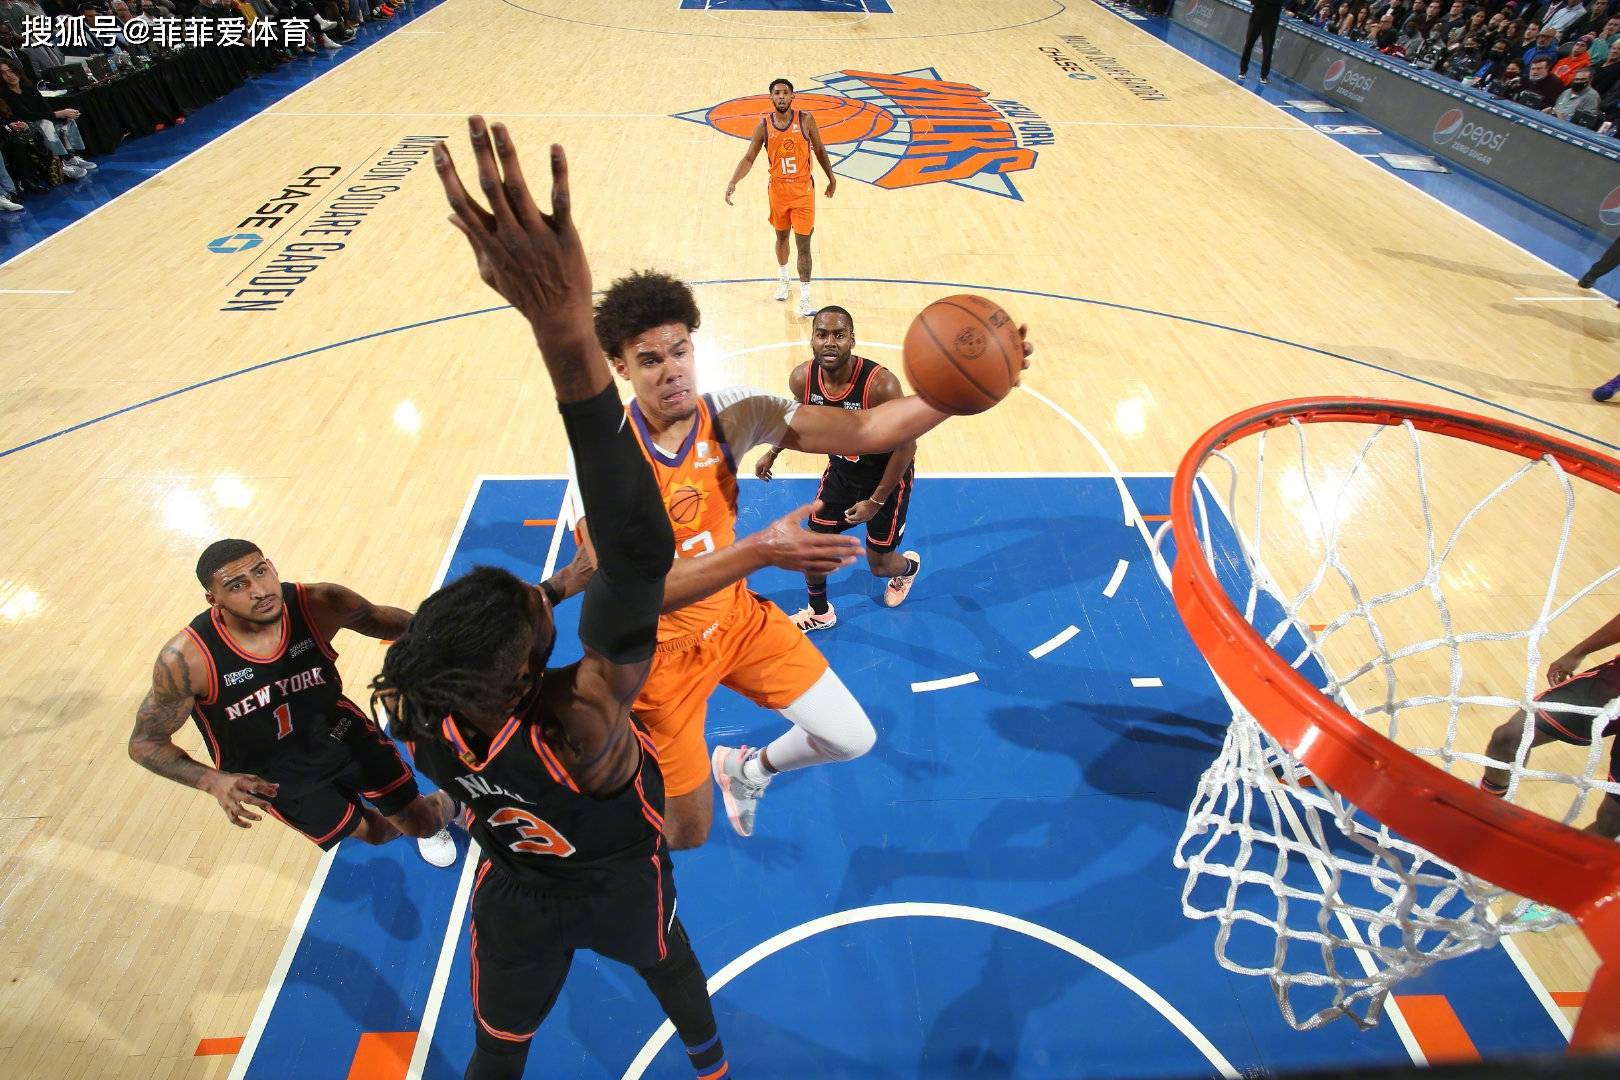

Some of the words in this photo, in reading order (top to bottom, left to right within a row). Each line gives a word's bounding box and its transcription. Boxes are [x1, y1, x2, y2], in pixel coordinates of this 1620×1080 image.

[1038, 46, 1085, 72] CHASE
[1341, 70, 1377, 92] pepsi
[1014, 120, 1055, 147] YORK
[1457, 122, 1510, 153] pepsi
[360, 135, 449, 180] MADISON
[781, 156, 798, 175] 15
[1451, 142, 1470, 154] ZERO
[1468, 149, 1493, 166] SUGAR
[237, 165, 342, 229] CHASE
[300, 185, 401, 236] SQUARE
[219, 242, 346, 311] GARDEN
[224, 685, 271, 721] NEW
[275, 666, 327, 697] YORK
[273, 702, 293, 741] 1
[487, 807, 576, 858] 3
